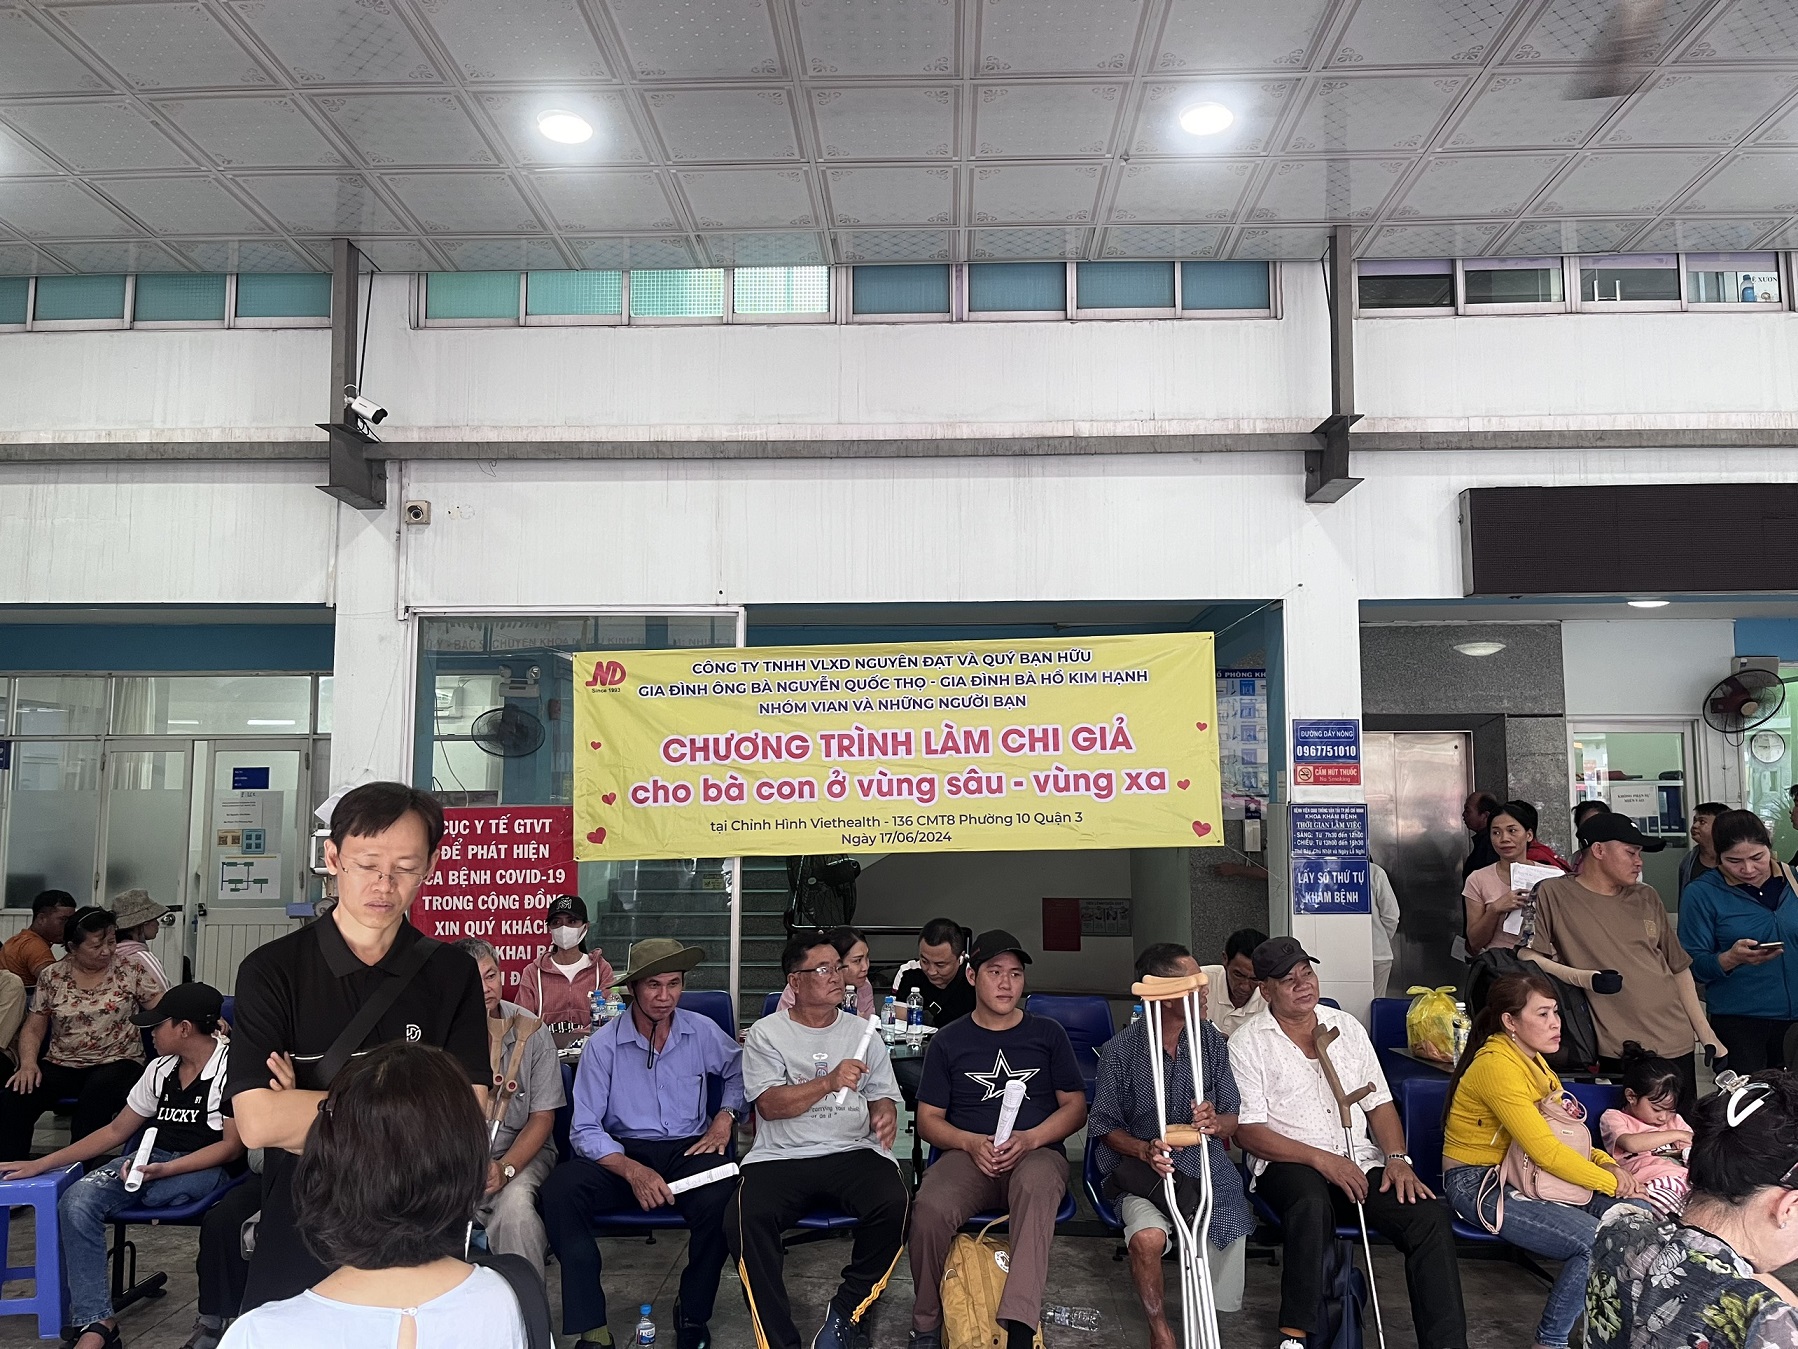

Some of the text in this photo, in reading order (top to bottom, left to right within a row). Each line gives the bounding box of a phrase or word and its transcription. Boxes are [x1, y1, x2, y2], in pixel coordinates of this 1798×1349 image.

[691, 648, 1092, 675] CÔNG TY TNHH VLXD NGUYÊN ĐẠT VÀ QUÝ BẠN HỮU
[586, 660, 627, 687] ND
[638, 685, 666, 698] GIA
[669, 680, 708, 697] ĐÌNH
[712, 679, 746, 696] ÔNG
[751, 678, 773, 694] BÀ
[777, 675, 840, 693] NGUYỄN
[844, 674, 891, 692] QUỐC
[893, 677, 926, 692] THỌ
[940, 675, 967, 688] GIA
[971, 670, 1010, 687] ĐÌNH
[1015, 669, 1036, 686] BÀ
[1041, 668, 1065, 685] HỒ
[1069, 672, 1097, 685] KIM
[1102, 670, 1148, 687] HẠNH
[759, 693, 1027, 715] NHÓM VIAN VÀ NHỮNG NGƯỜI BẠN
[662, 716, 1133, 763] CHƯƠNG TRÌNH LÀM CHI GIẢ
[1296, 745, 1357, 757] 0967751010
[1315, 766, 1358, 777] CẤM HÚT THUỐC
[630, 779, 692, 805] cho
[703, 774, 745, 803] bà
[755, 779, 815, 802] con
[826, 769, 847, 799] ở
[857, 770, 935, 804] vùng
[946, 767, 1003, 796] sâu
[1032, 765, 1115, 799] vùng
[1123, 770, 1167, 792] xa
[474, 820, 485, 834] Y
[489, 813, 512, 834] TẾ
[513, 818, 553, 834] GTVT
[710, 819, 728, 835] tại
[775, 817, 807, 830] Hình
[811, 815, 881, 829] Viethealth
[892, 815, 914, 827] 136
[916, 813, 955, 826] CMT8
[959, 811, 1012, 828] Phường
[1016, 813, 1030, 824] 10
[1034, 811, 1071, 827] Quận
[1074, 812, 1083, 824] 3
[1346, 820, 1362, 829] VIỆC
[440, 838, 550, 861] ĐỂ PHÁT HIỆN
[841, 831, 952, 847] Ngày 17/06/2024
[448, 866, 491, 888] BỆNH
[495, 868, 566, 885] COVID-19
[1297, 867, 1365, 886] LẤY SỐ THỨ TỰ
[422, 895, 474, 911] TRONG
[477, 891, 520, 913] CỘNG
[523, 888, 564, 910] ĐỒN
[1334, 888, 1359, 906] BỆNH
[434, 921, 460, 936] XIN
[464, 916, 496, 938] QUÝ
[157, 1106, 200, 1123] LUCKY
